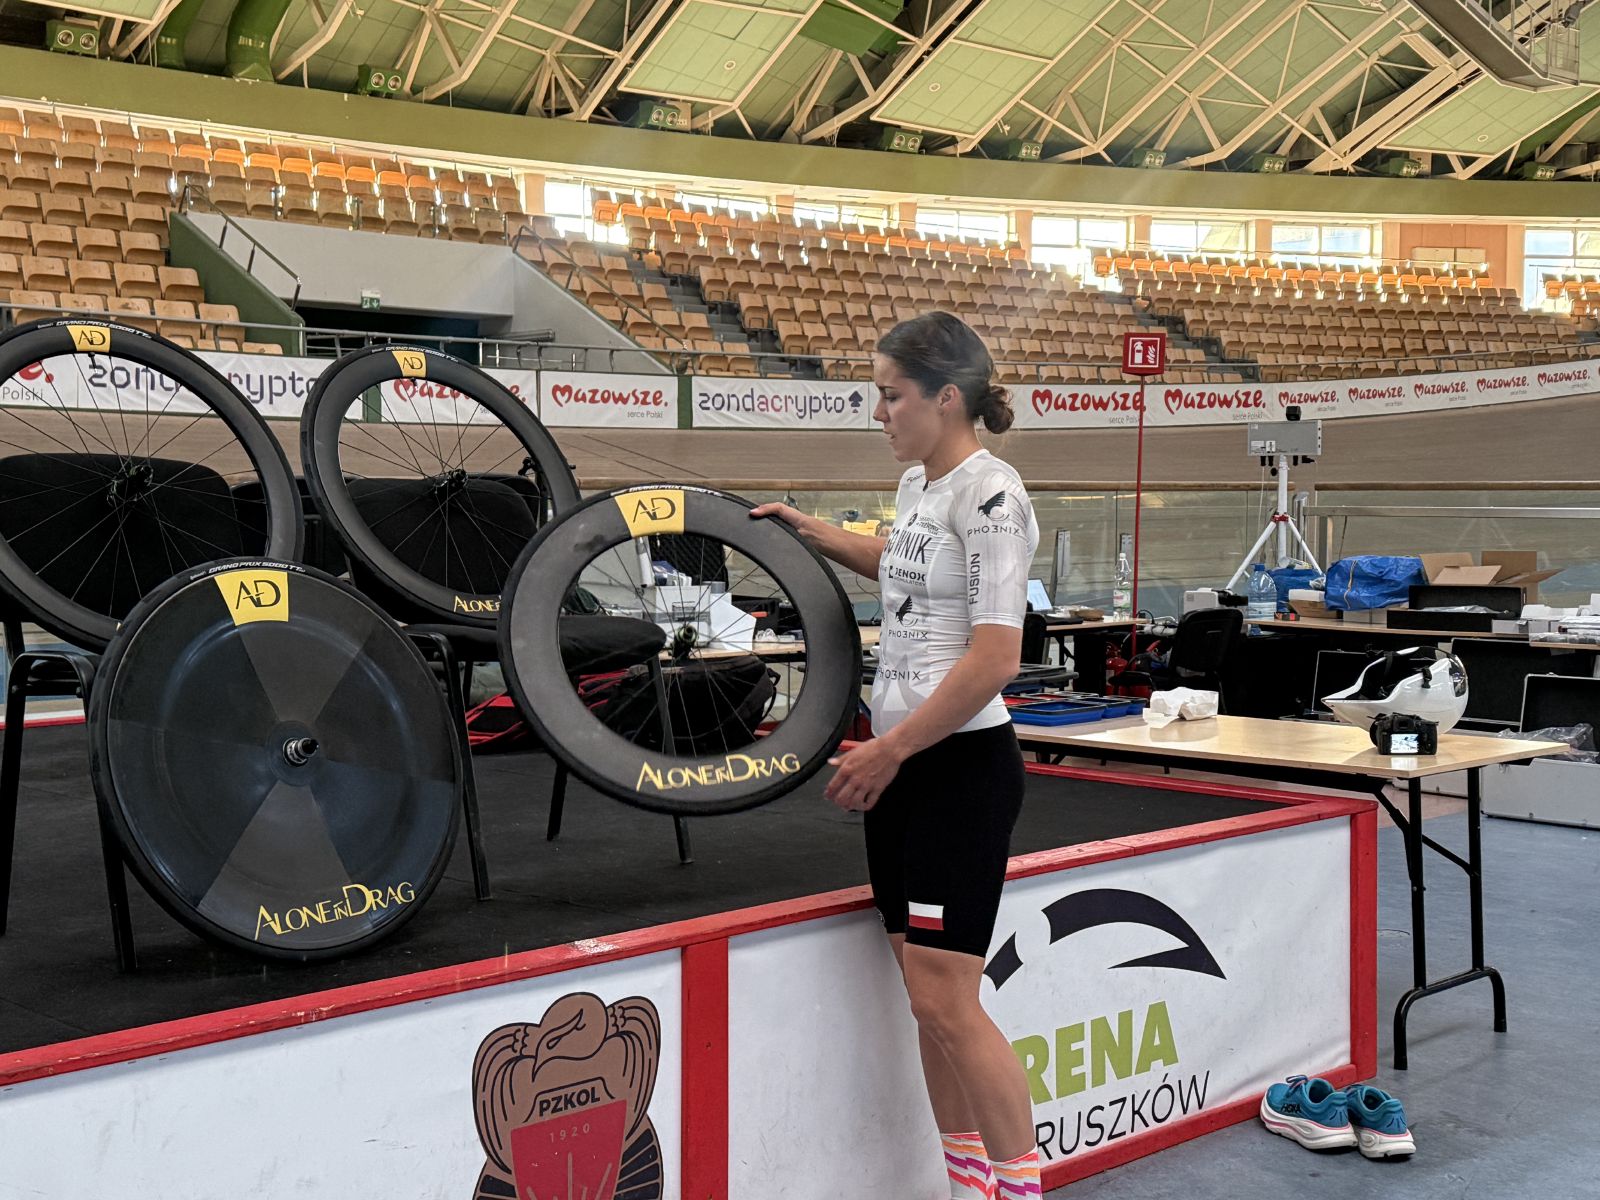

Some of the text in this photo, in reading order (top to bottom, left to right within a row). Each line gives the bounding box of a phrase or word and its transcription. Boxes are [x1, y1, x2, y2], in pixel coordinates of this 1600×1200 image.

[2, 386, 44, 401] Polski
[698, 388, 845, 419] zondacrypto
[208, 562, 239, 574] GRAND
[261, 561, 289, 569] 5000
[968, 552, 981, 605] FUSION
[1011, 1000, 1179, 1106] RENA
[538, 1086, 601, 1117] PZKOL
[1035, 1070, 1210, 1161] RUSZKÓW
[550, 1122, 591, 1143] 1920
